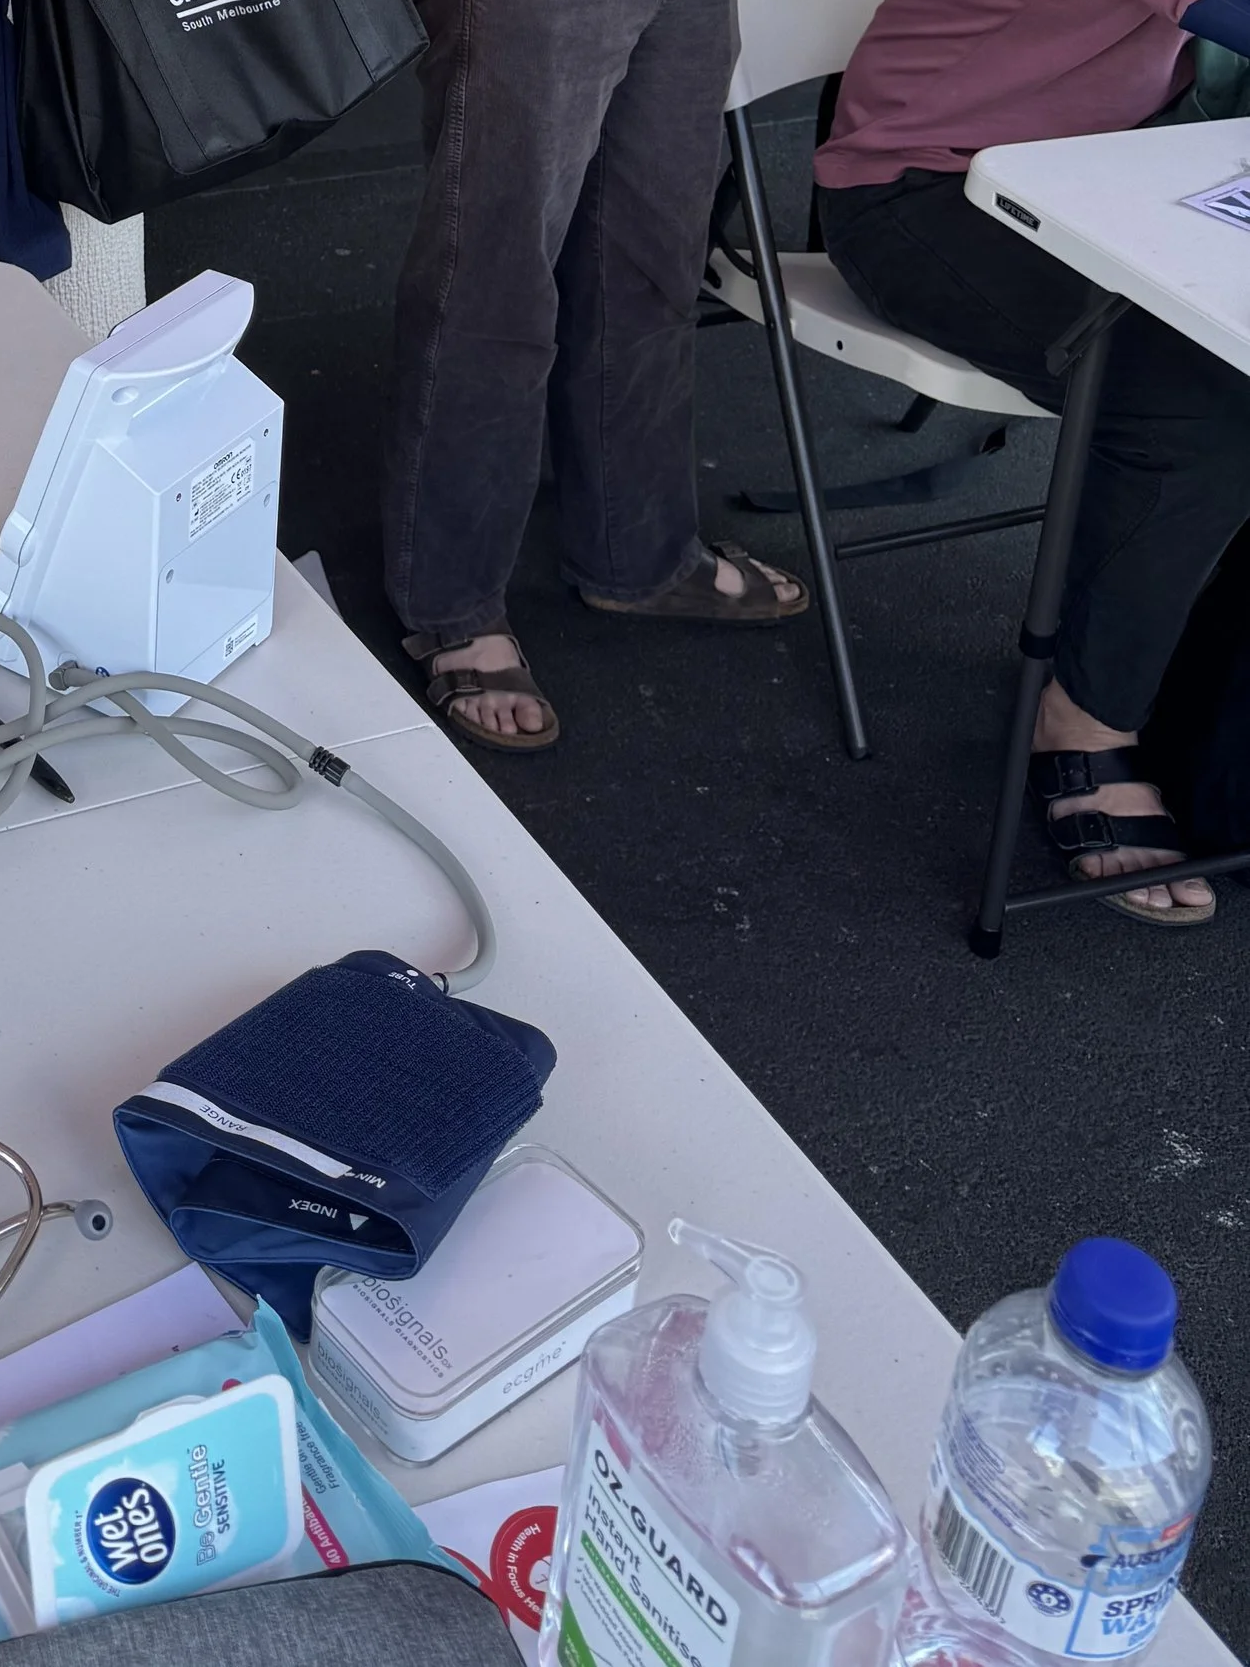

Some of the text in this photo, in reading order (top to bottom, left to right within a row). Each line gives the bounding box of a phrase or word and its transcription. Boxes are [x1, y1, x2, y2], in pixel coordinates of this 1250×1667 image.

[181, 14, 214, 32] South
[388, 971, 417, 990] TUBE
[199, 1104, 248, 1132] RANGE
[354, 1170, 387, 1190] MIN
[289, 1198, 338, 1219] INDEX
[352, 1284, 395, 1326] BIOSIGNALS
[395, 1328, 445, 1379] DIAGNOSTICS
[304, 1461, 328, 1495] Gentle
[306, 1441, 340, 1490] Fragrance
[189, 1444, 217, 1566] Be Gentle
[212, 1458, 231, 1535] SENSITIVE
[122, 1483, 169, 1565] ones
[510, 1522, 542, 1552] Health
[585, 1505, 626, 1577] Hand
[588, 1485, 643, 1573] Instant
[594, 1449, 728, 1627] OZ-GUARD
[326, 1548, 343, 1566] 40
[507, 1564, 526, 1599] Focus
